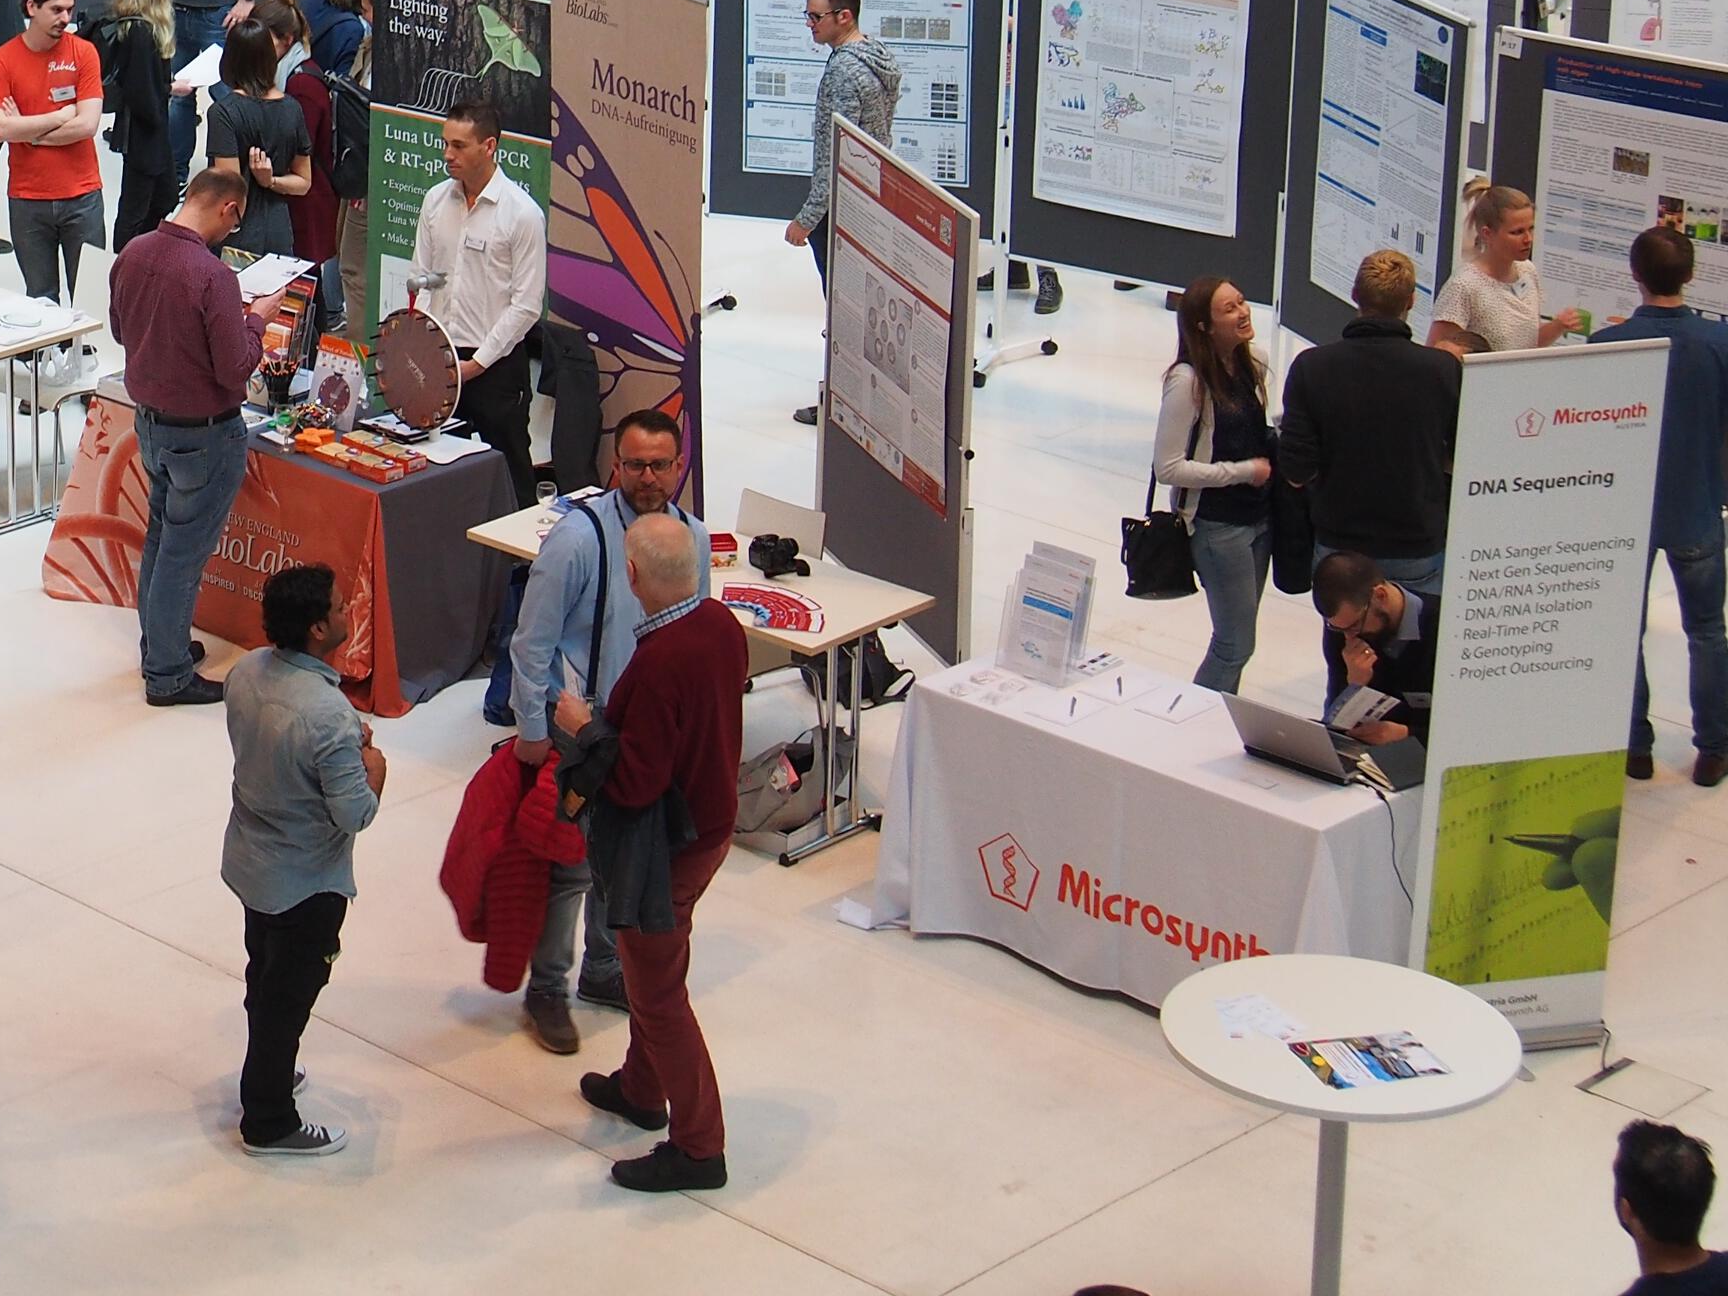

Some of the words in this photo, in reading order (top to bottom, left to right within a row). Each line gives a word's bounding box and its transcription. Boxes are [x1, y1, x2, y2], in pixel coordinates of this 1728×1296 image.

[389, 17, 411, 35] the
[414, 25, 446, 45] way.
[590, 58, 697, 125] Monarch
[384, 124, 418, 144] Luna
[590, 98, 698, 154] DNA-Aufreinigung
[384, 149, 396, 163] &
[387, 213, 407, 225] Luna
[387, 232, 408, 245] Make
[1552, 402, 1648, 426] Microsynth
[1468, 479, 1508, 497] DNA
[1512, 469, 1615, 494] Sequencing
[246, 517, 300, 547] ENGLAND
[1470, 549, 1502, 562] DNA
[1505, 544, 1552, 560] Sanger
[1555, 537, 1636, 554] Sequencing
[1468, 568, 1500, 582] Next
[1503, 564, 1531, 579] Gen
[1534, 558, 1615, 576] Sequencing
[202, 571, 235, 592] INSPIRED
[243, 585, 264, 602] DISCO
[1466, 583, 1534, 602] DNA/RNA
[1537, 577, 1601, 597] Synthesis
[1464, 602, 1532, 621] DNA/RNA
[1535, 599, 1593, 614] Isolation
[1463, 623, 1529, 641] Real-Time
[1532, 619, 1560, 633] PCR
[1461, 647, 1473, 661] &
[1473, 641, 1553, 659] Genotyping
[1459, 664, 1507, 681] Project
[1509, 656, 1594, 675] Outsourcing
[1508, 994, 1538, 1005] GmbH
